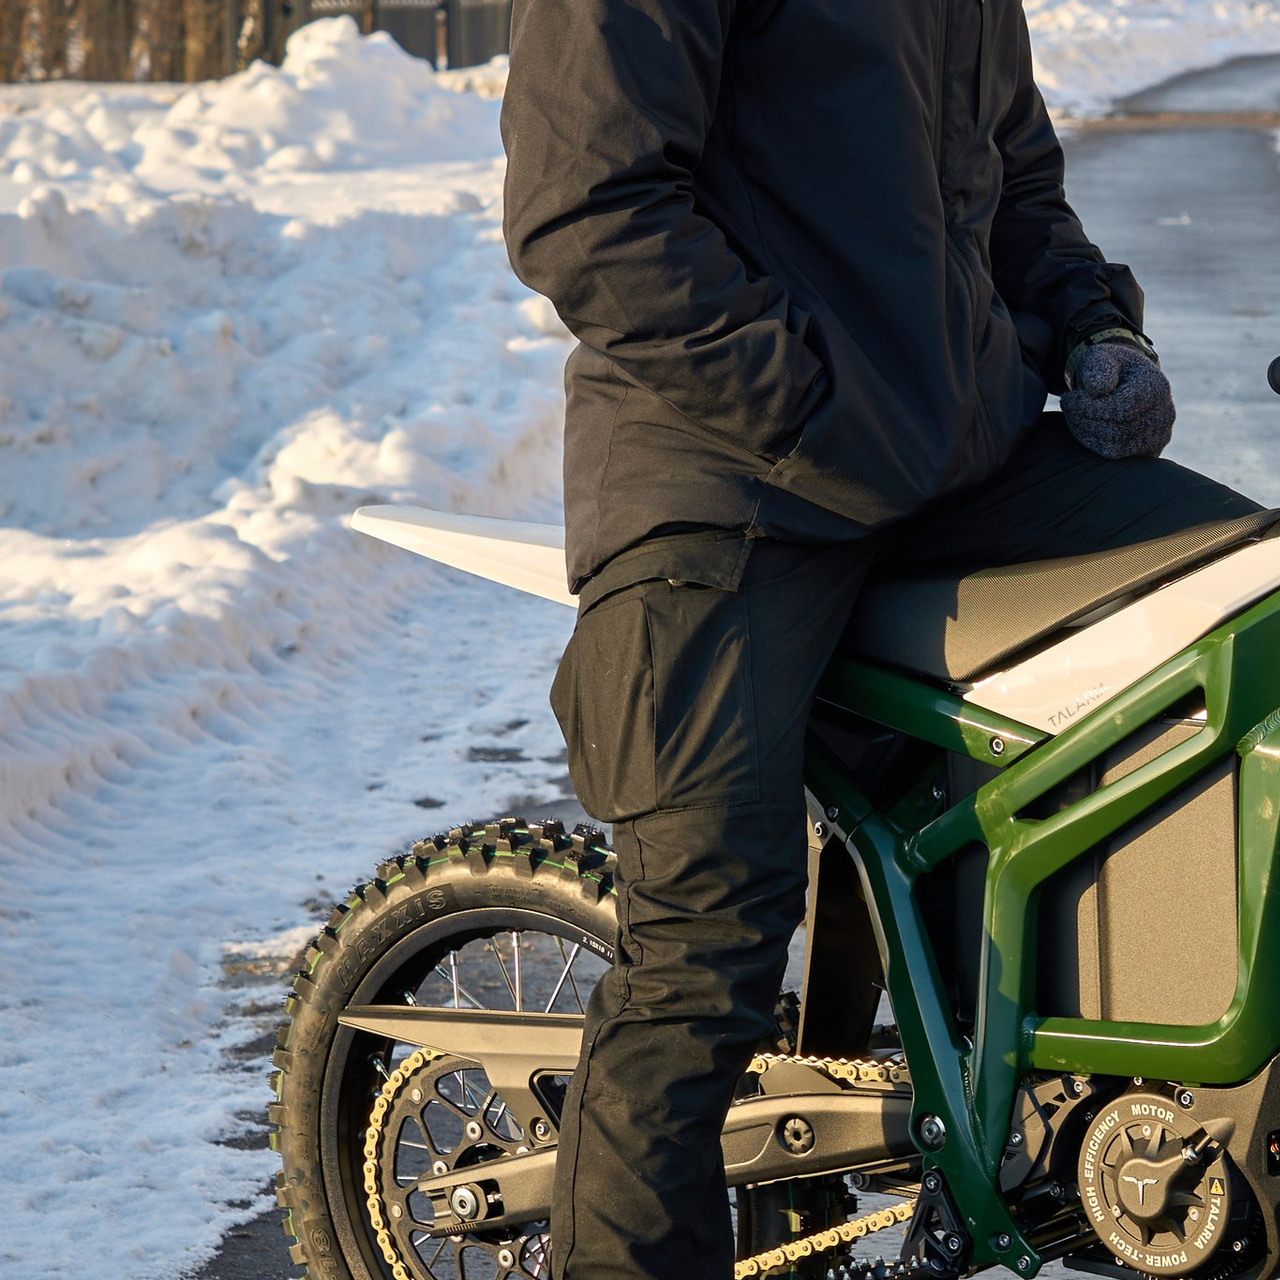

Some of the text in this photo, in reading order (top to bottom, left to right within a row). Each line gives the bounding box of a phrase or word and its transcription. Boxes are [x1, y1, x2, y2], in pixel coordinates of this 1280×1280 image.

[1048, 683, 1110, 727] TALARIA
[337, 890, 447, 989] MAXXIS
[1131, 1104, 1175, 1124] MOTOR
[1194, 1197, 1222, 1250] TALARIA
